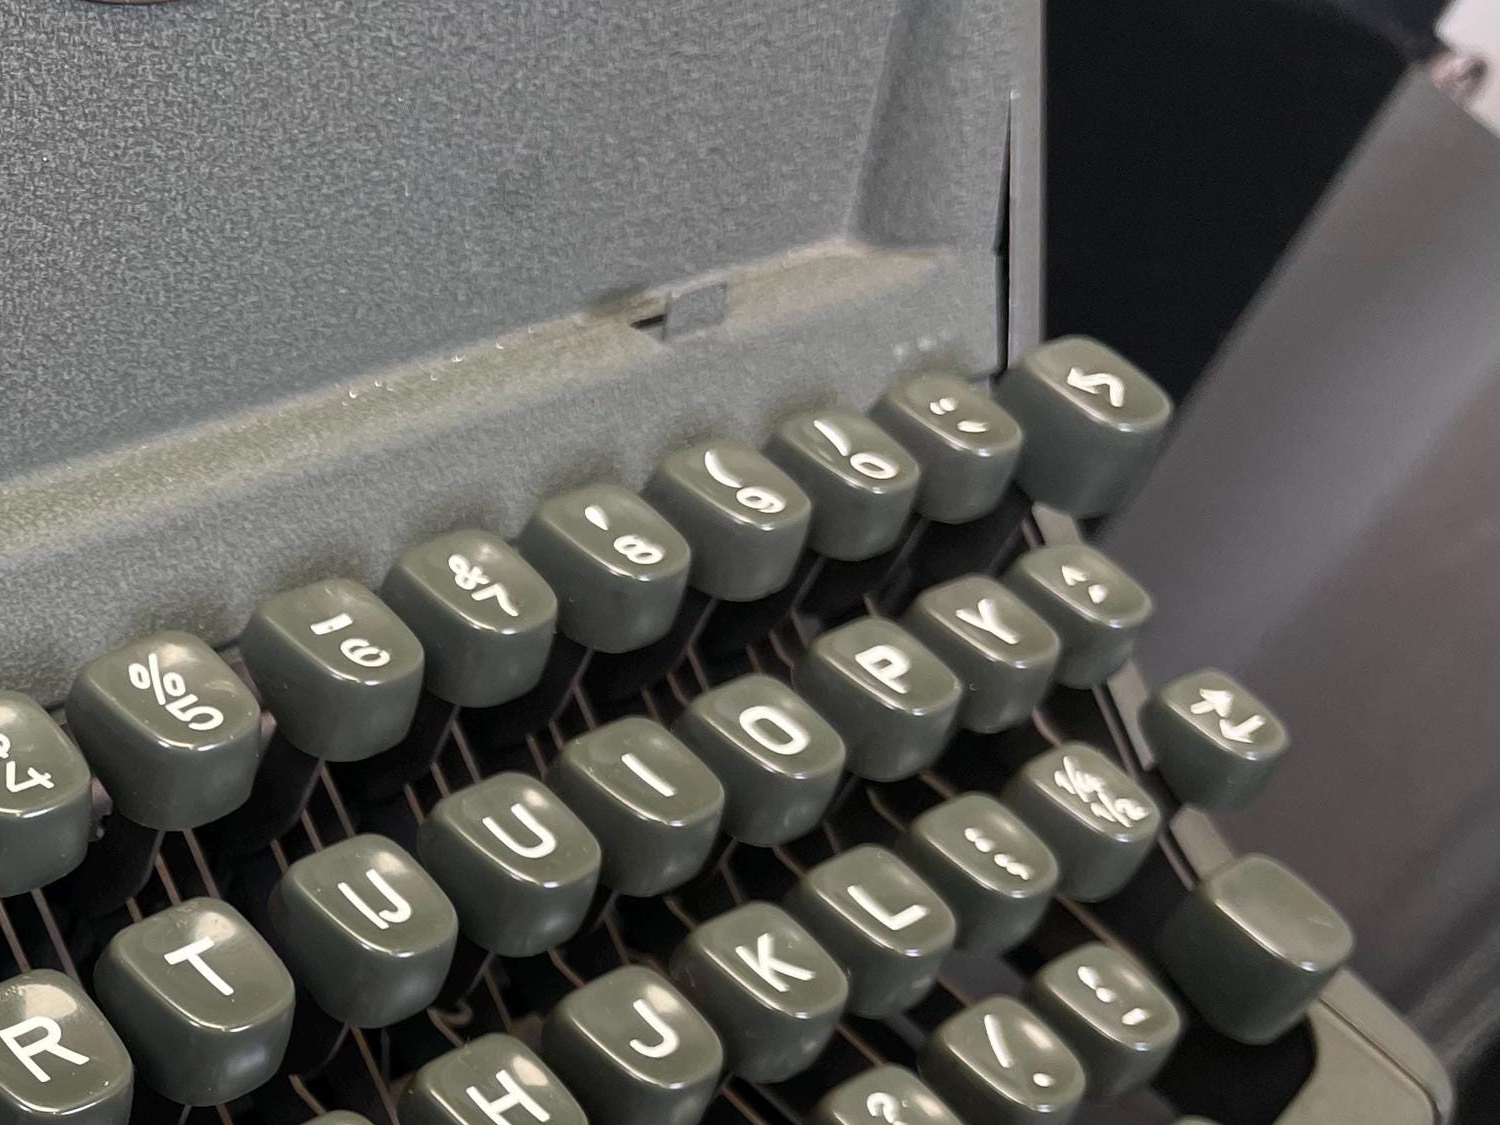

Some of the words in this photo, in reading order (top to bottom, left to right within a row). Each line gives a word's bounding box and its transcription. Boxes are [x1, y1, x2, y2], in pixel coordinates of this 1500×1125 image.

[851, 454, 895, 478] 0
[737, 488, 784, 512] 9
[614, 536, 662, 564] 8
[448, 554, 485, 590] &
[472, 585, 519, 617] 7
[957, 599, 1016, 643] Y
[341, 639, 389, 666] 6
[856, 646, 908, 693] P
[128, 653, 186, 705] %
[166, 694, 223, 730] 5
[740, 707, 807, 754] O
[7, 761, 53, 792] 4
[622, 754, 673, 796] I
[483, 804, 555, 857] U
[848, 886, 925, 930] L
[164, 938, 234, 996] T
[736, 934, 812, 991] K
[629, 1000, 679, 1058] J
